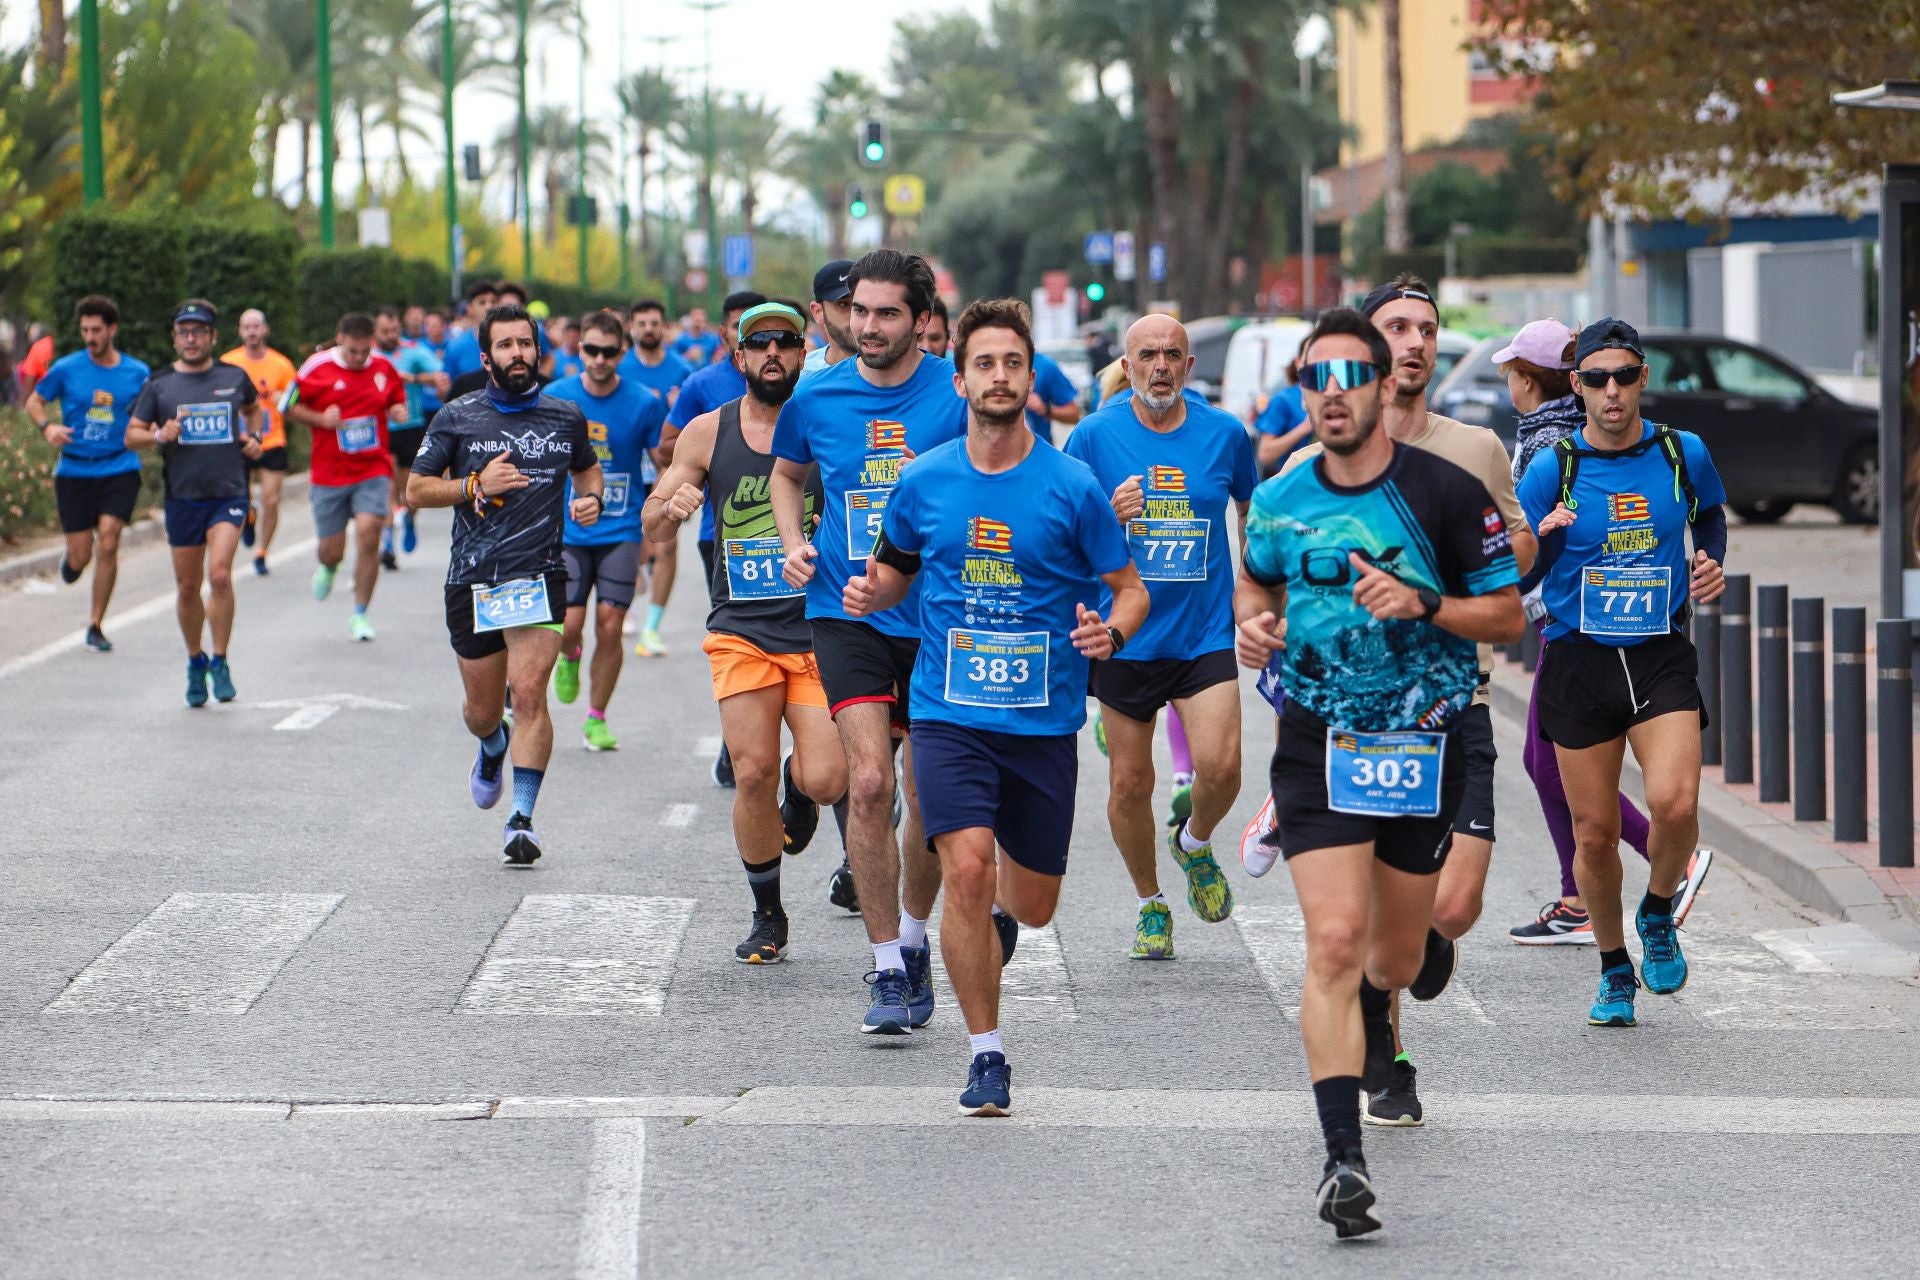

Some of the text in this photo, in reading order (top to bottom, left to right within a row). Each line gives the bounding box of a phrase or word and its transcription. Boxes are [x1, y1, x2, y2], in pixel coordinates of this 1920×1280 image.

[183, 416, 227, 432] 1016
[468, 440, 573, 454] ANIBAL RACE
[859, 471, 868, 484] X
[733, 475, 770, 503] RU
[1146, 498, 1190, 510] MUÉVETE
[1150, 509, 1194, 519] VALENCIA
[1607, 528, 1654, 544] MUÉVETE
[1143, 540, 1195, 561] 777
[1601, 543, 1609, 554] X
[1611, 537, 1658, 553] VALENCIA
[742, 558, 786, 581] 81
[965, 557, 1014, 572] MUÉVETE
[960, 569, 1023, 585] X VALENCIA
[490, 594, 534, 617] 215
[1600, 591, 1652, 614] 771
[1007, 646, 1013, 655] X
[1013, 645, 1044, 655] VALENCIA
[968, 656, 1029, 684] 383
[982, 685, 1014, 693] ANTONIO
[1351, 757, 1422, 789] 303
